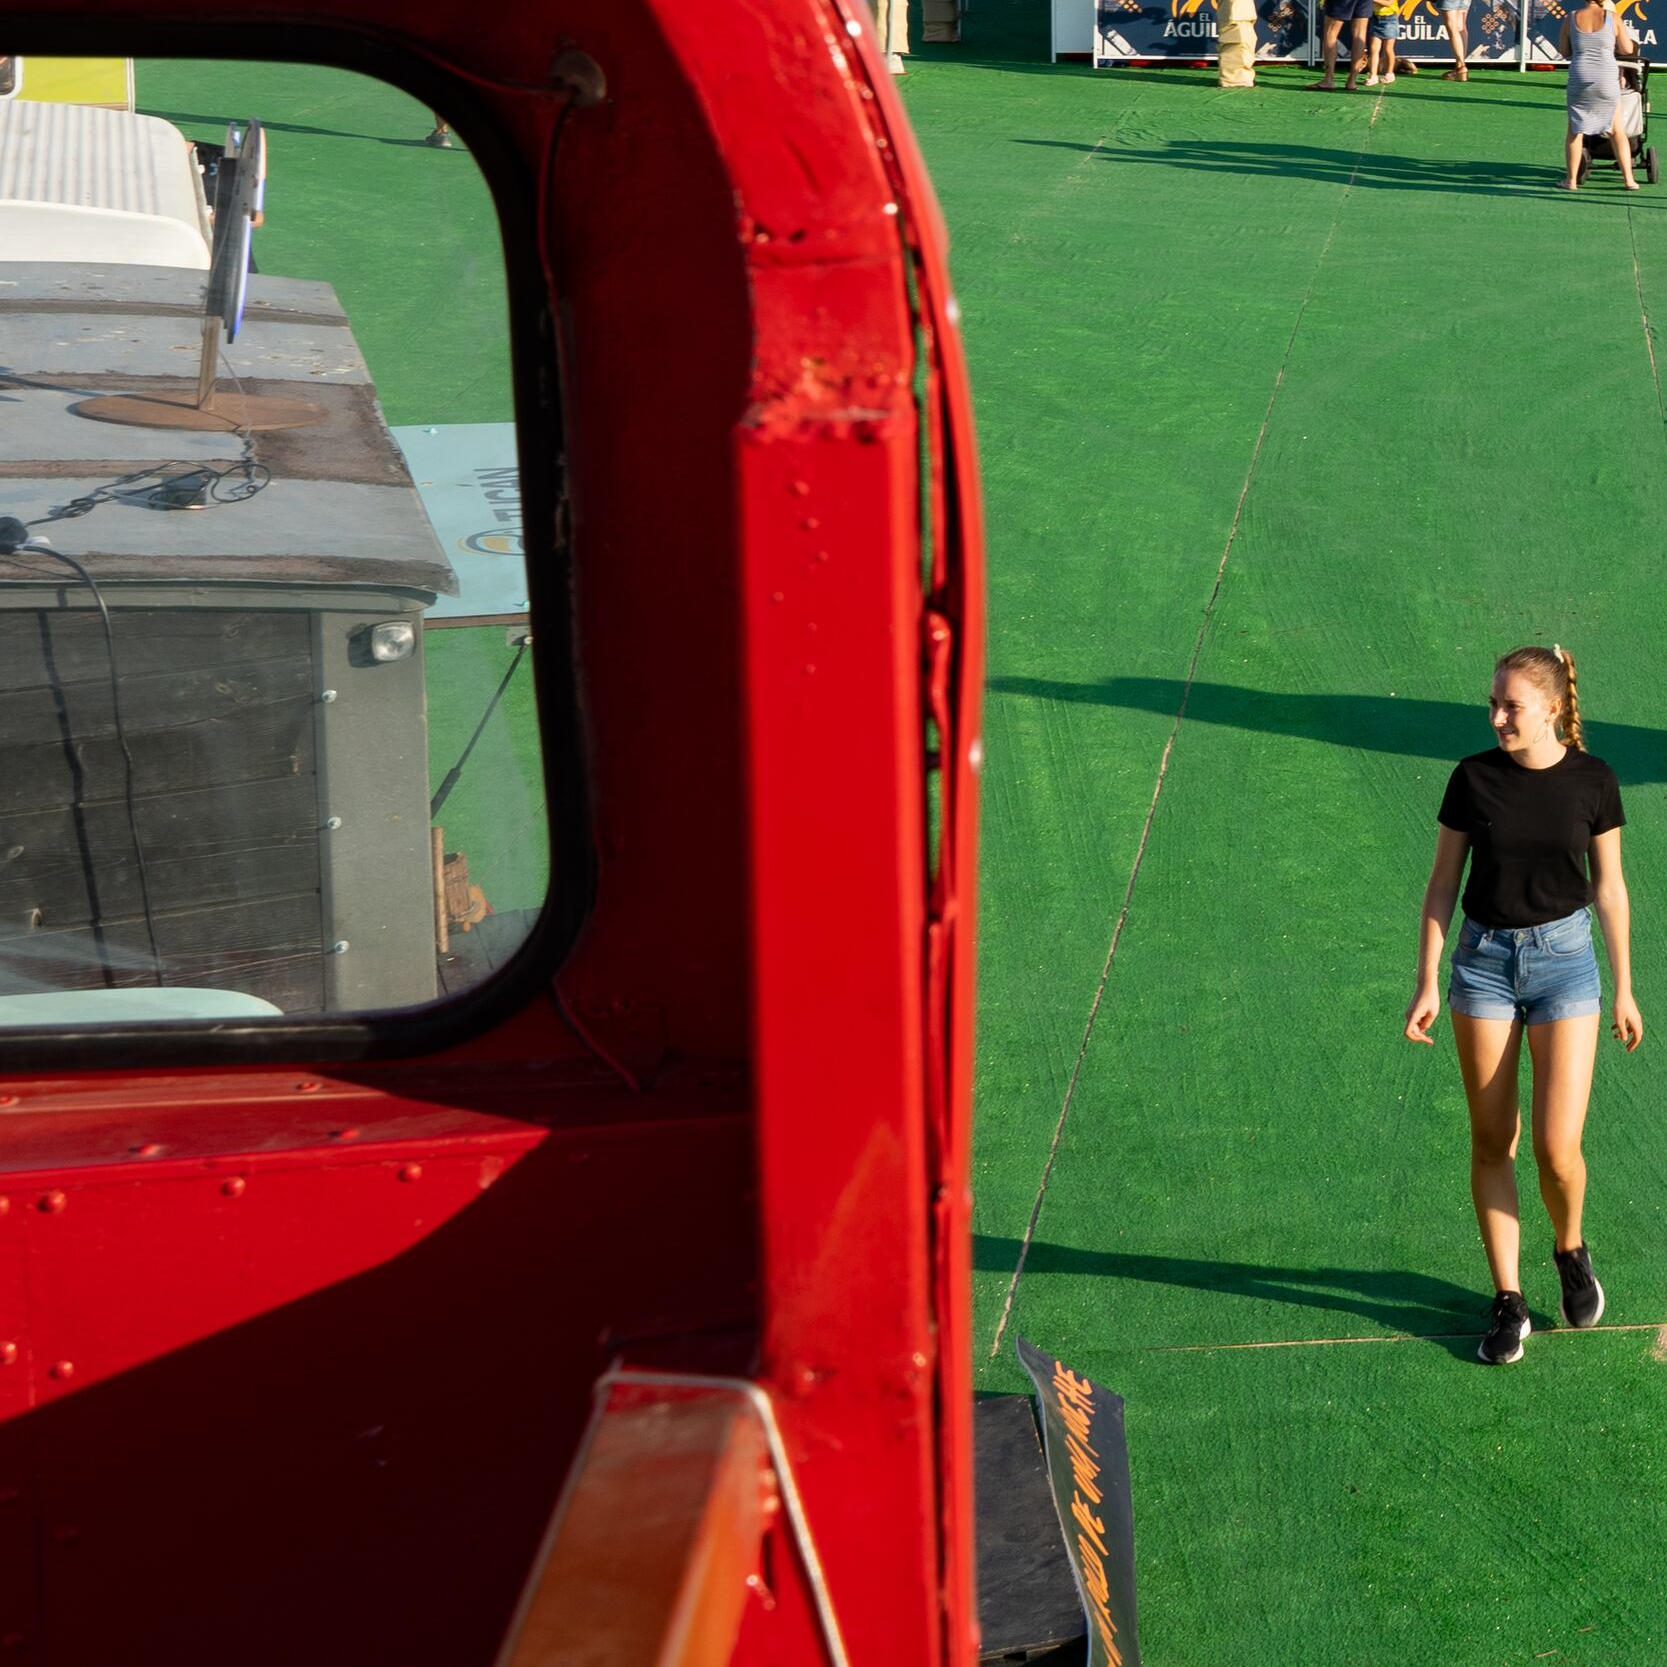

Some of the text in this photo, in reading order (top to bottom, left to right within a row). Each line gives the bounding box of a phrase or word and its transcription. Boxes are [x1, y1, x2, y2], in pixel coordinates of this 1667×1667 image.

[1200, 13, 1209, 21] EL
[1414, 15, 1426, 25] EL
[1163, 20, 1219, 38] ÁGUIL
[1397, 24, 1450, 40] GUILA
